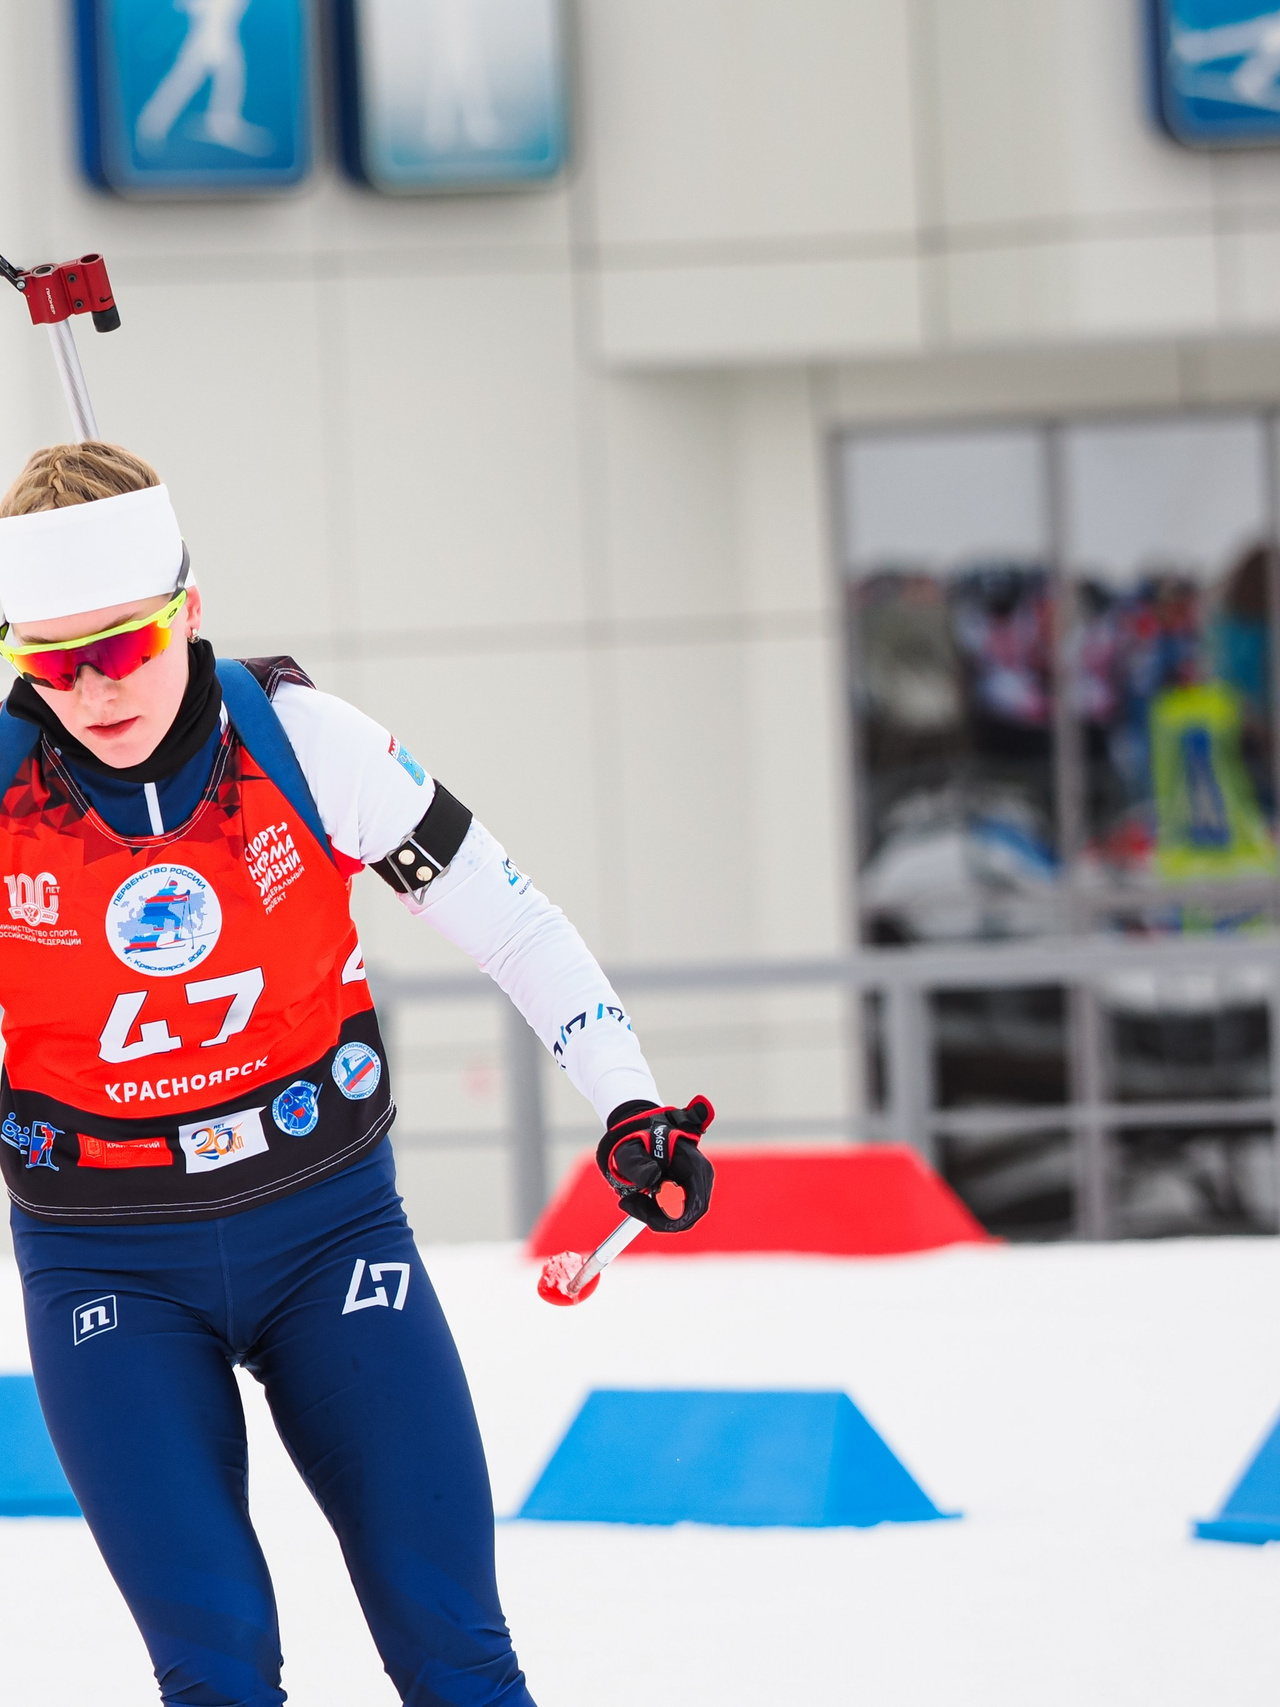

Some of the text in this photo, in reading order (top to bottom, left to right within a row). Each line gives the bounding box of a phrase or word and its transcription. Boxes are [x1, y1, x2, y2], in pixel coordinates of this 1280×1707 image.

[248, 834, 295, 880] НОРМА
[255, 849, 301, 897] ЖИЗНИ
[45, 886, 60, 894] ЛЕТ
[113, 867, 207, 906] ПЕРВЕНСТВО РОССИИ
[37, 938, 81, 946] ФЕДЕРАЦИИ
[134, 959, 186, 972] Красноярск
[188, 944, 207, 963] 2023
[98, 966, 265, 1063] 47
[104, 1056, 268, 1103] КРАСНОЯРСК
